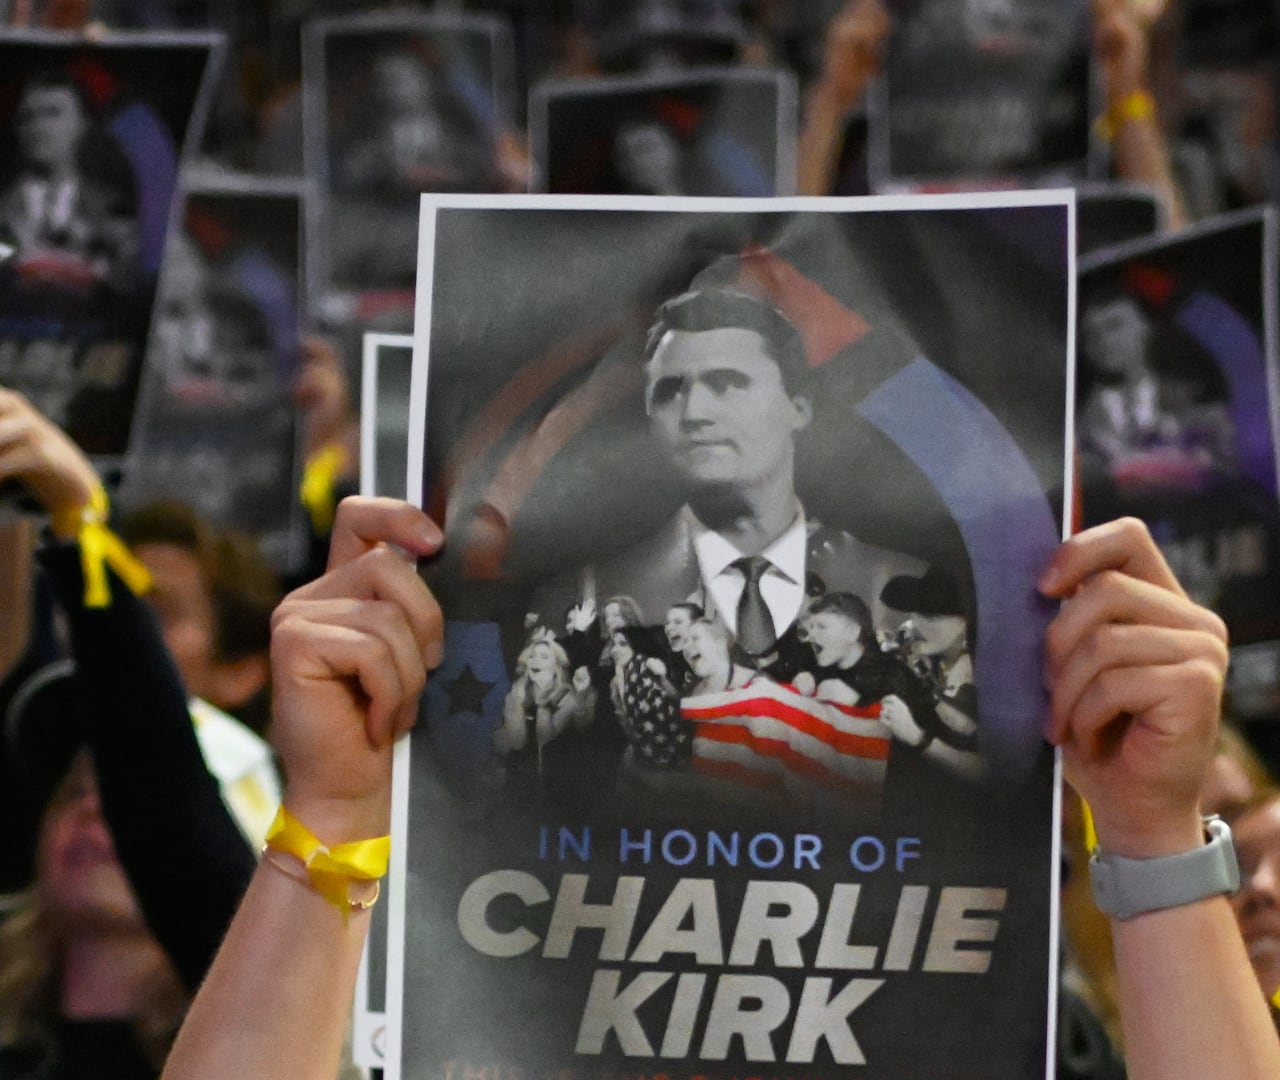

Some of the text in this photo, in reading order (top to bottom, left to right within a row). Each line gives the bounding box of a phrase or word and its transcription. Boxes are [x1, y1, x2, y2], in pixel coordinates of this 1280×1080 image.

[538, 826, 921, 873] IN HONOR OF
[457, 870, 1008, 974] CHARLIE
[575, 970, 886, 1066] KIRK
